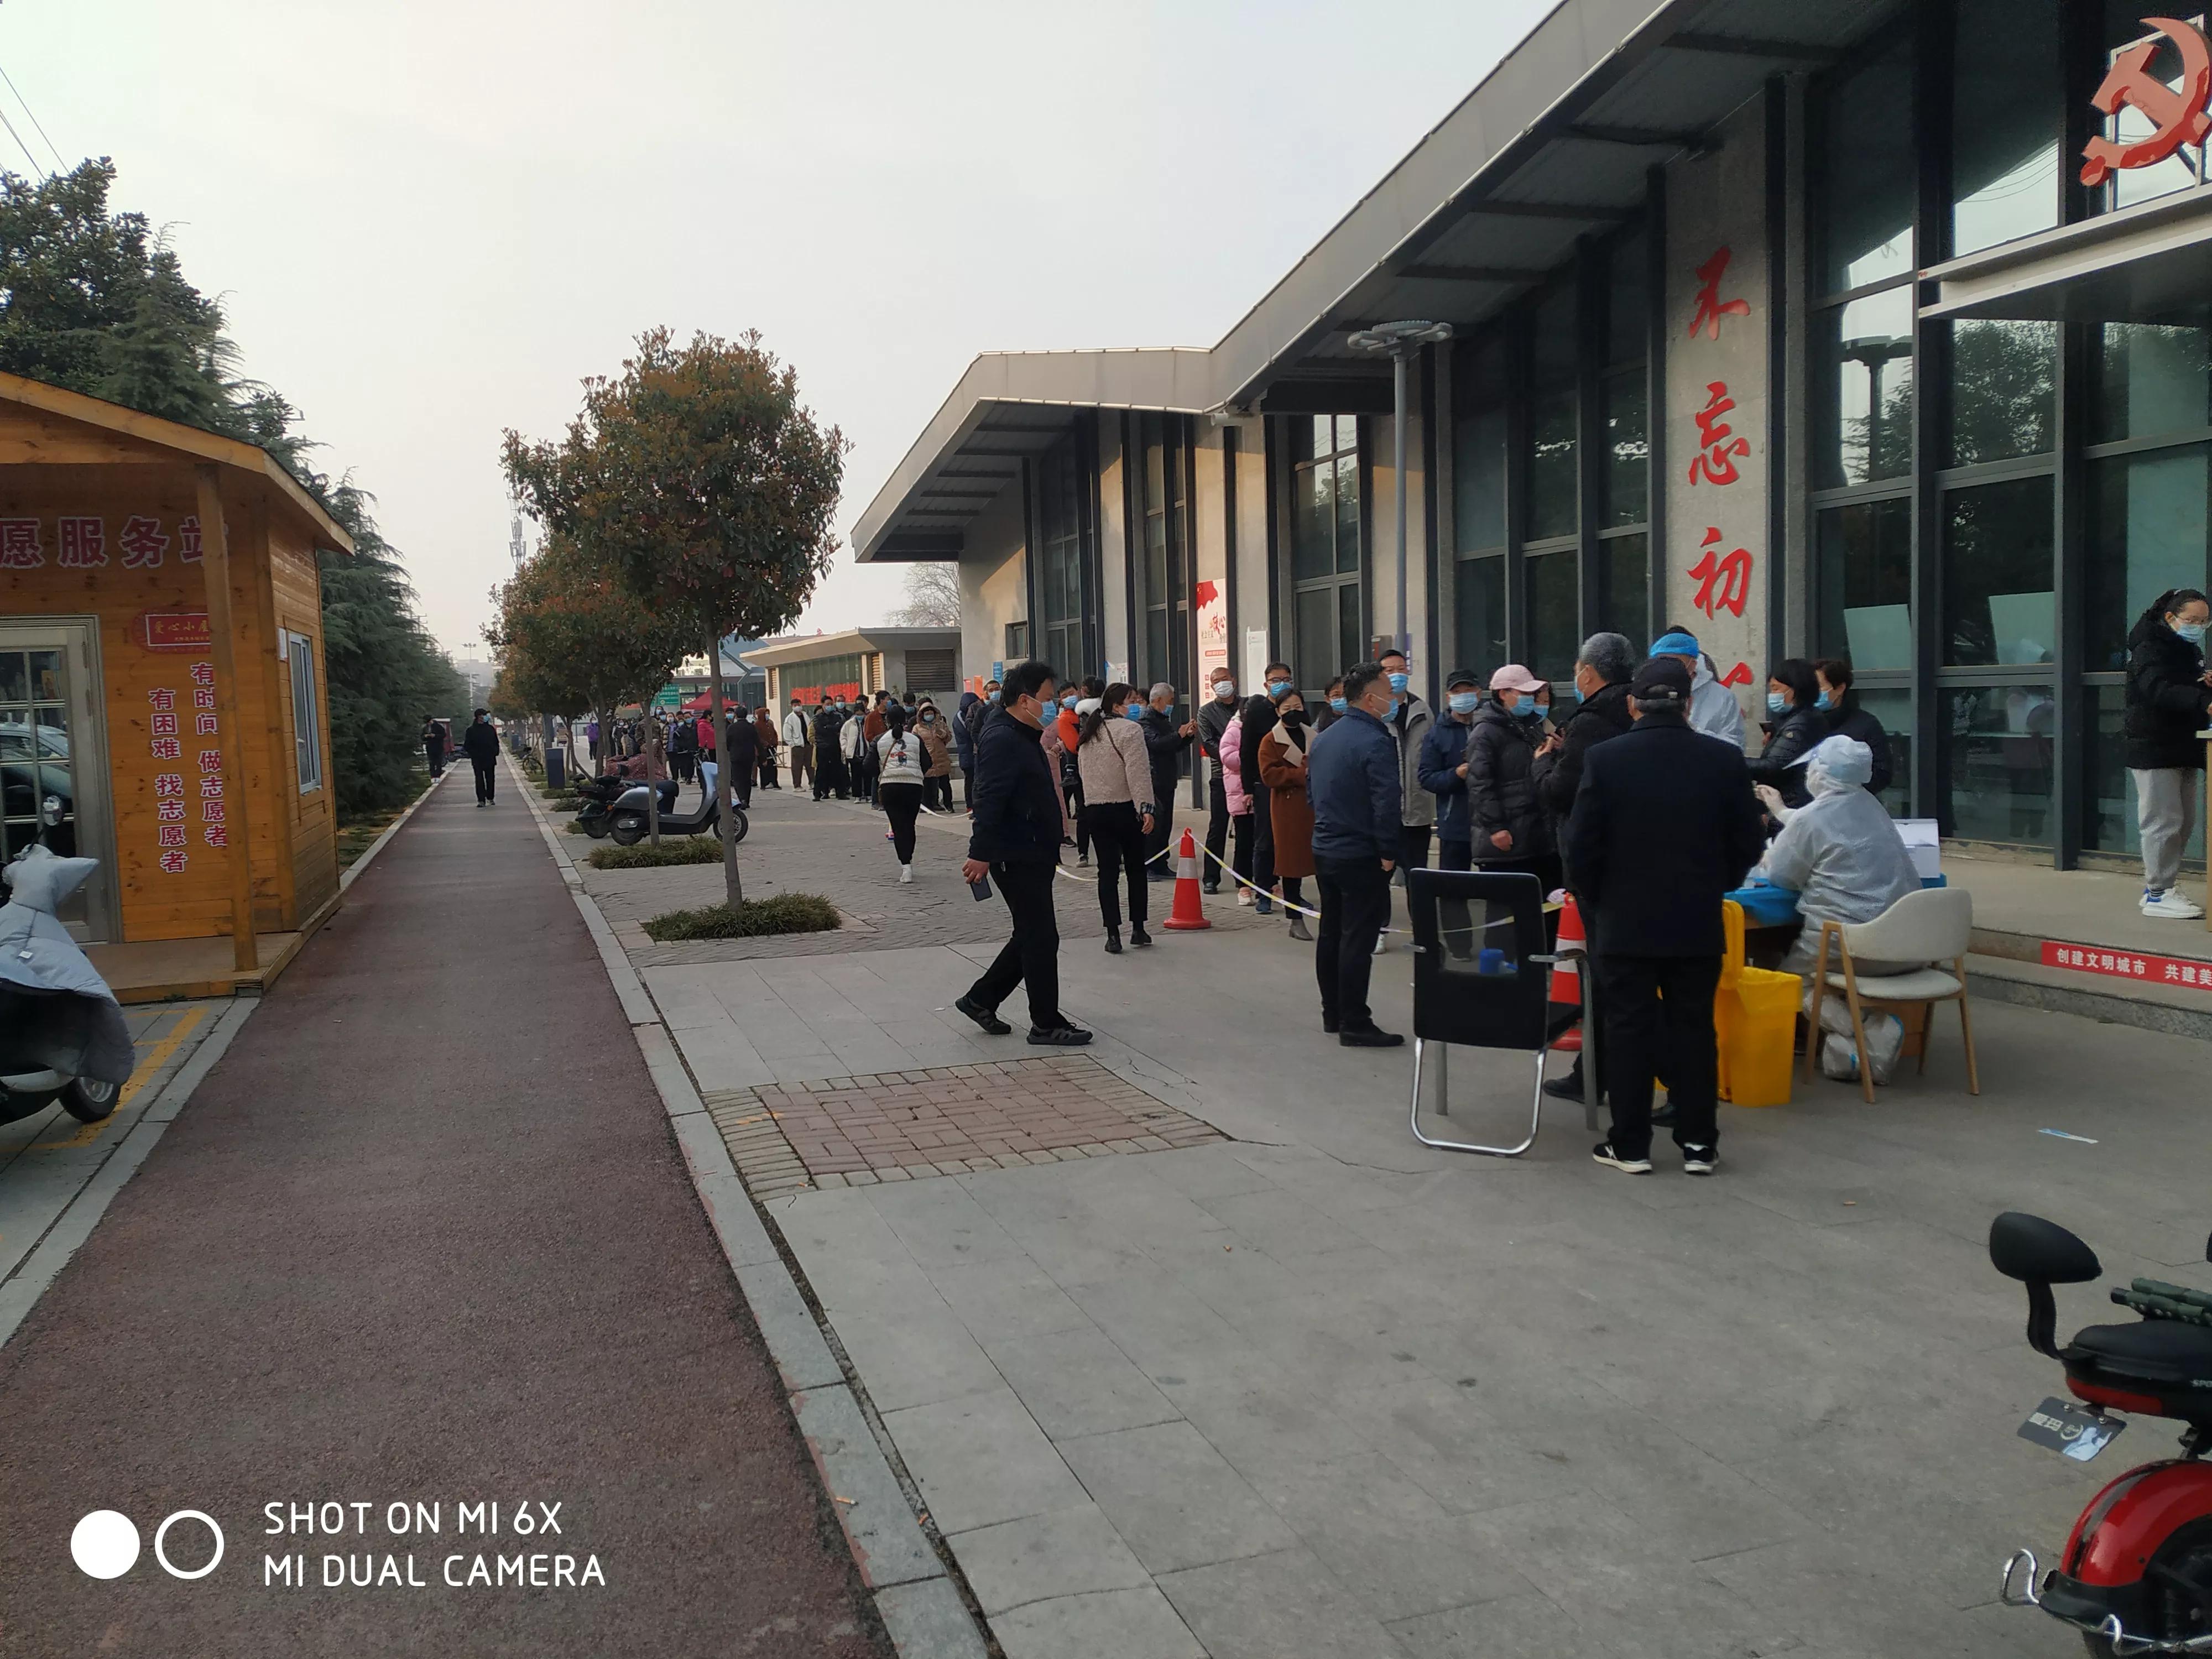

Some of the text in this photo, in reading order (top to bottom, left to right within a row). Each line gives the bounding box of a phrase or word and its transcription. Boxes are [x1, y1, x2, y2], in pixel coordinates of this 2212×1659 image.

[1688, 246, 1754, 697] 不忘初
[191, 662, 219, 735] 有时间
[148, 688, 188, 873] 有困难 找志愿者
[198, 750, 228, 847] 做志愿者
[2057, 947, 2212, 987] 创建文明城市 共建美
